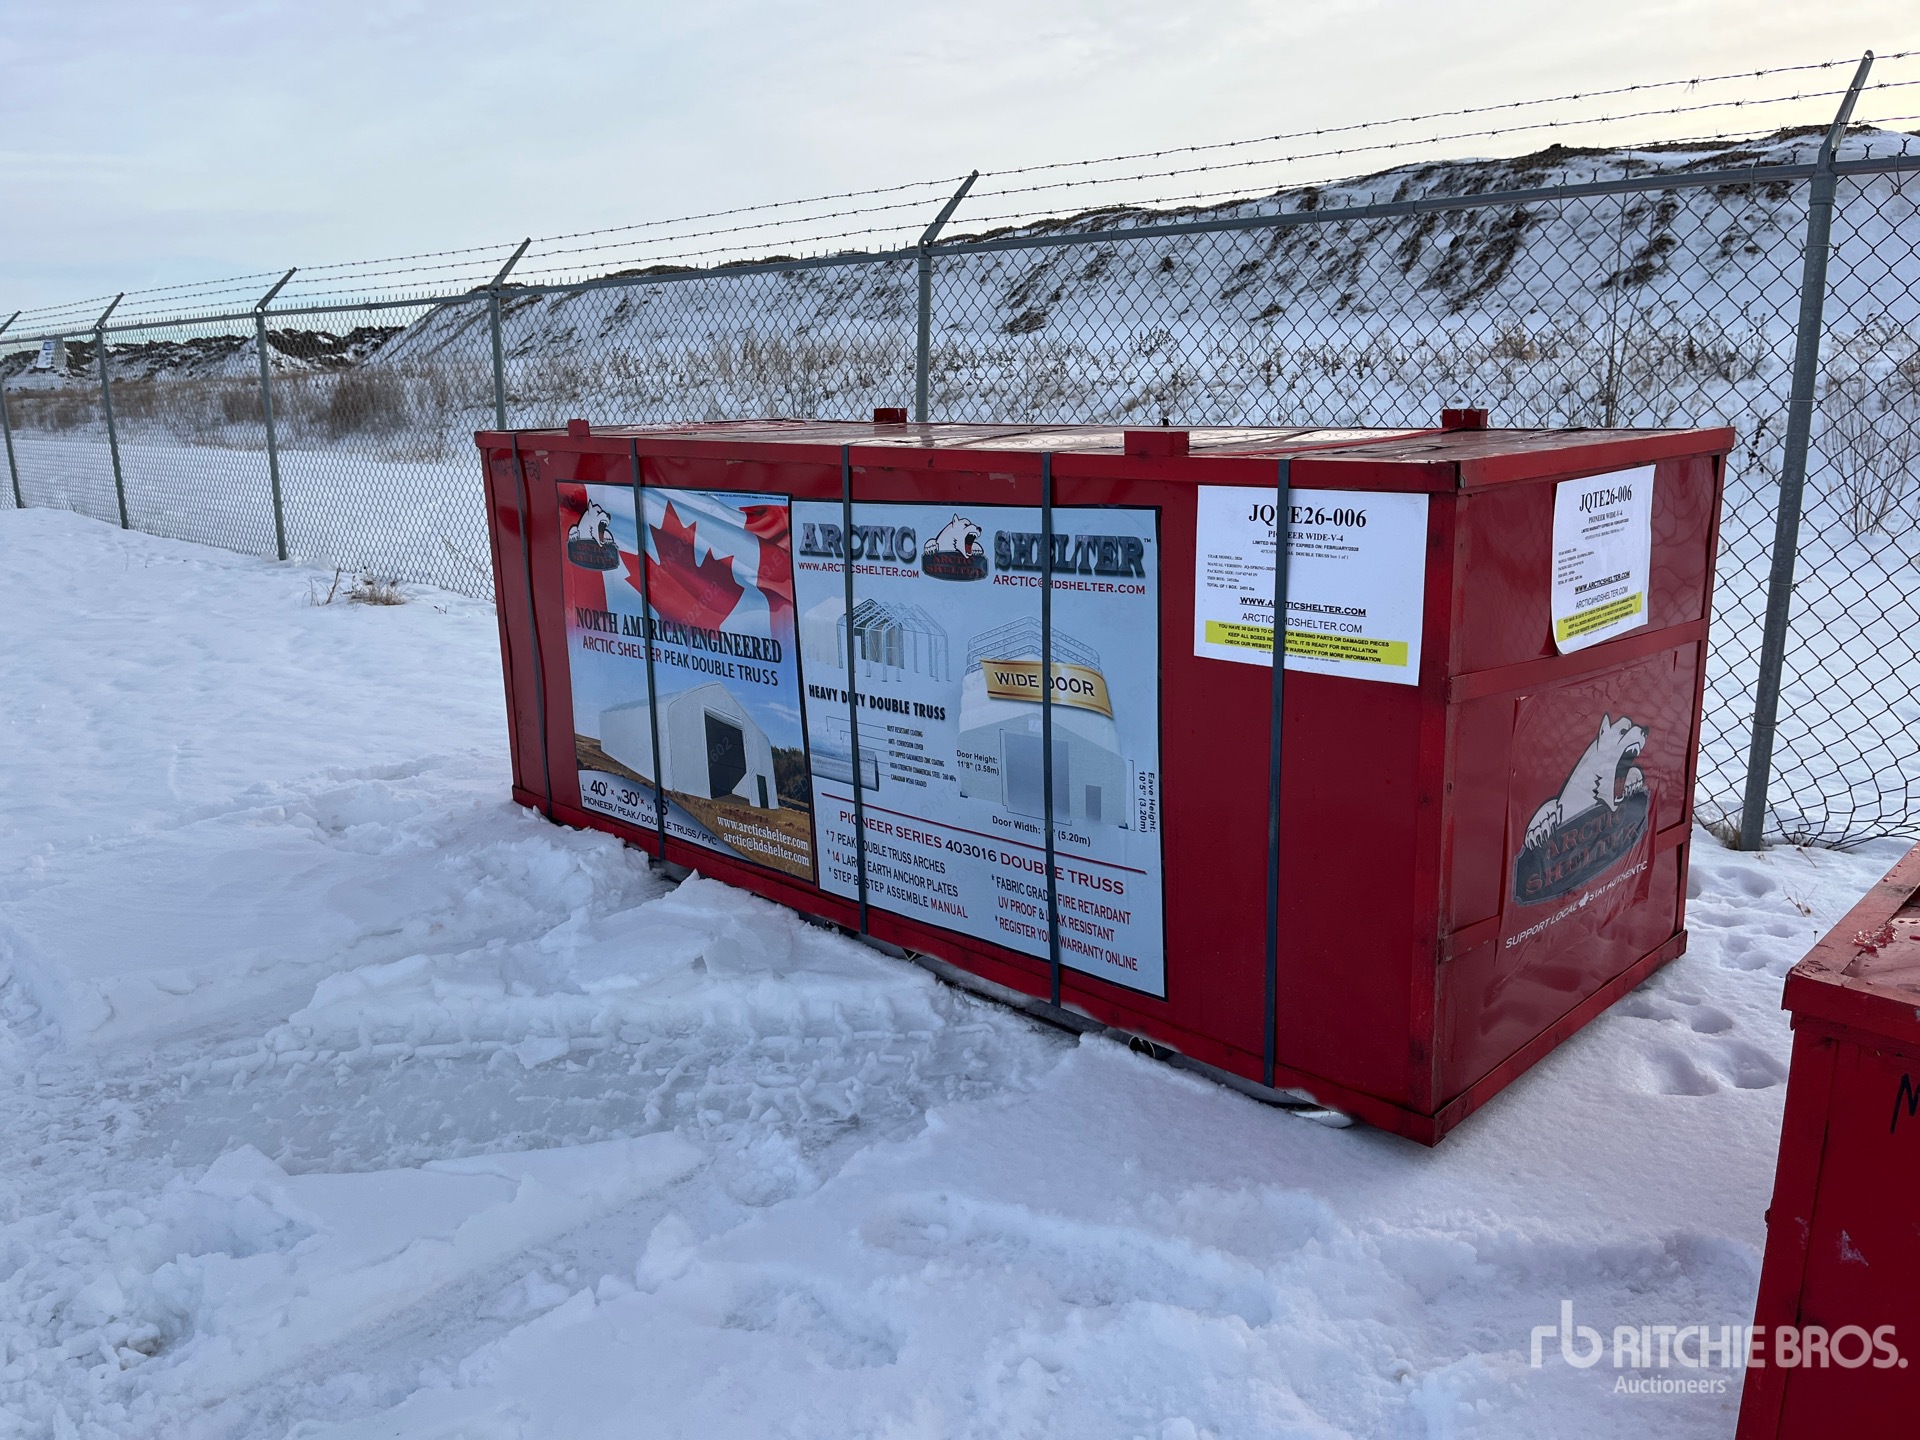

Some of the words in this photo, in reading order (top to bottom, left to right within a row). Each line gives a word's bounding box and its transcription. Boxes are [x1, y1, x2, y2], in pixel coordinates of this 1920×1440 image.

[1248, 504, 1367, 528] JQE26-006
[1579, 484, 1632, 513] JQTE26-006
[799, 522, 917, 565] ARCTIC
[1306, 533, 1344, 542] WIDE-V-4
[798, 561, 920, 579] WWW.ARCTCSHELTER.COM
[1240, 596, 1366, 616] WWW.ATICSHELTER.COM
[1242, 612, 1363, 633] ARCTICHDSHELTER.COM
[575, 607, 618, 635] NORTH
[691, 628, 782, 664] ENGINEERED
[1340, 645, 1378, 654] INSTALLATION
[1343, 637, 1368, 645] DAMAGED
[582, 635, 615, 655] ARCTIC
[617, 641, 662, 663] SHELER
[664, 653, 690, 669] PEAK
[692, 657, 735, 678] DOUBLE
[737, 664, 779, 687] TRUSS
[1289, 647, 1317, 656] WARRANTY
[1329, 651, 1344, 659] MORE
[1345, 653, 1381, 662] INFORMATION
[994, 671, 1040, 688] WIDE
[808, 684, 838, 702] HEAVY
[841, 690, 866, 707] DTY
[869, 695, 910, 715] DOUBLE
[912, 702, 946, 721] TRUSS
[956, 749, 973, 759] Door
[973, 753, 998, 765] Height:
[992, 815, 1012, 828] Door
[1014, 821, 1041, 835] Width:
[1058, 831, 1091, 847] (5.20m)
[1148, 798, 1157, 833] Height:
[1543, 804, 1627, 860] ARCTIC
[717, 816, 809, 851] www.arcticshelter.com
[723, 832, 810, 867] arctic@hdshelter.com
[837, 833, 856, 848] PEAK
[862, 840, 887, 858] OUBLE
[887, 848, 912, 864] TRUSS
[913, 855, 946, 875] ARCHES
[896, 826, 942, 849] SERIES
[945, 840, 997, 862] 403016
[1068, 869, 1124, 895] TRUSS
[1525, 822, 1639, 894] SHELTER
[832, 850, 840, 863] 14
[867, 860, 892, 879] EARTH
[893, 869, 926, 889] ANCHOR
[926, 879, 959, 898] PLATES
[833, 868, 851, 883] STEP
[865, 877, 885, 894] STEP
[886, 885, 929, 908] ASSEMBLE
[930, 897, 968, 919] MANUAL
[996, 876, 1024, 897] FABRIC
[1026, 884, 1049, 902] GRAD
[1058, 893, 1077, 911] FIRE
[1078, 899, 1131, 926] RETARDANT
[1505, 917, 1552, 949] SUPPORT
[1550, 904, 1578, 925] LOCAL
[1606, 860, 1648, 892] AUTHENTIC
[998, 896, 1009, 910] UV
[1010, 899, 1037, 918] PROOF
[1046, 910, 1067, 928] LAK
[1068, 916, 1115, 943] RESISTANT
[999, 918, 1036, 940] REGISTER
[1059, 935, 1105, 961] WARRANTY
[1105, 950, 1138, 972] ONLINE
